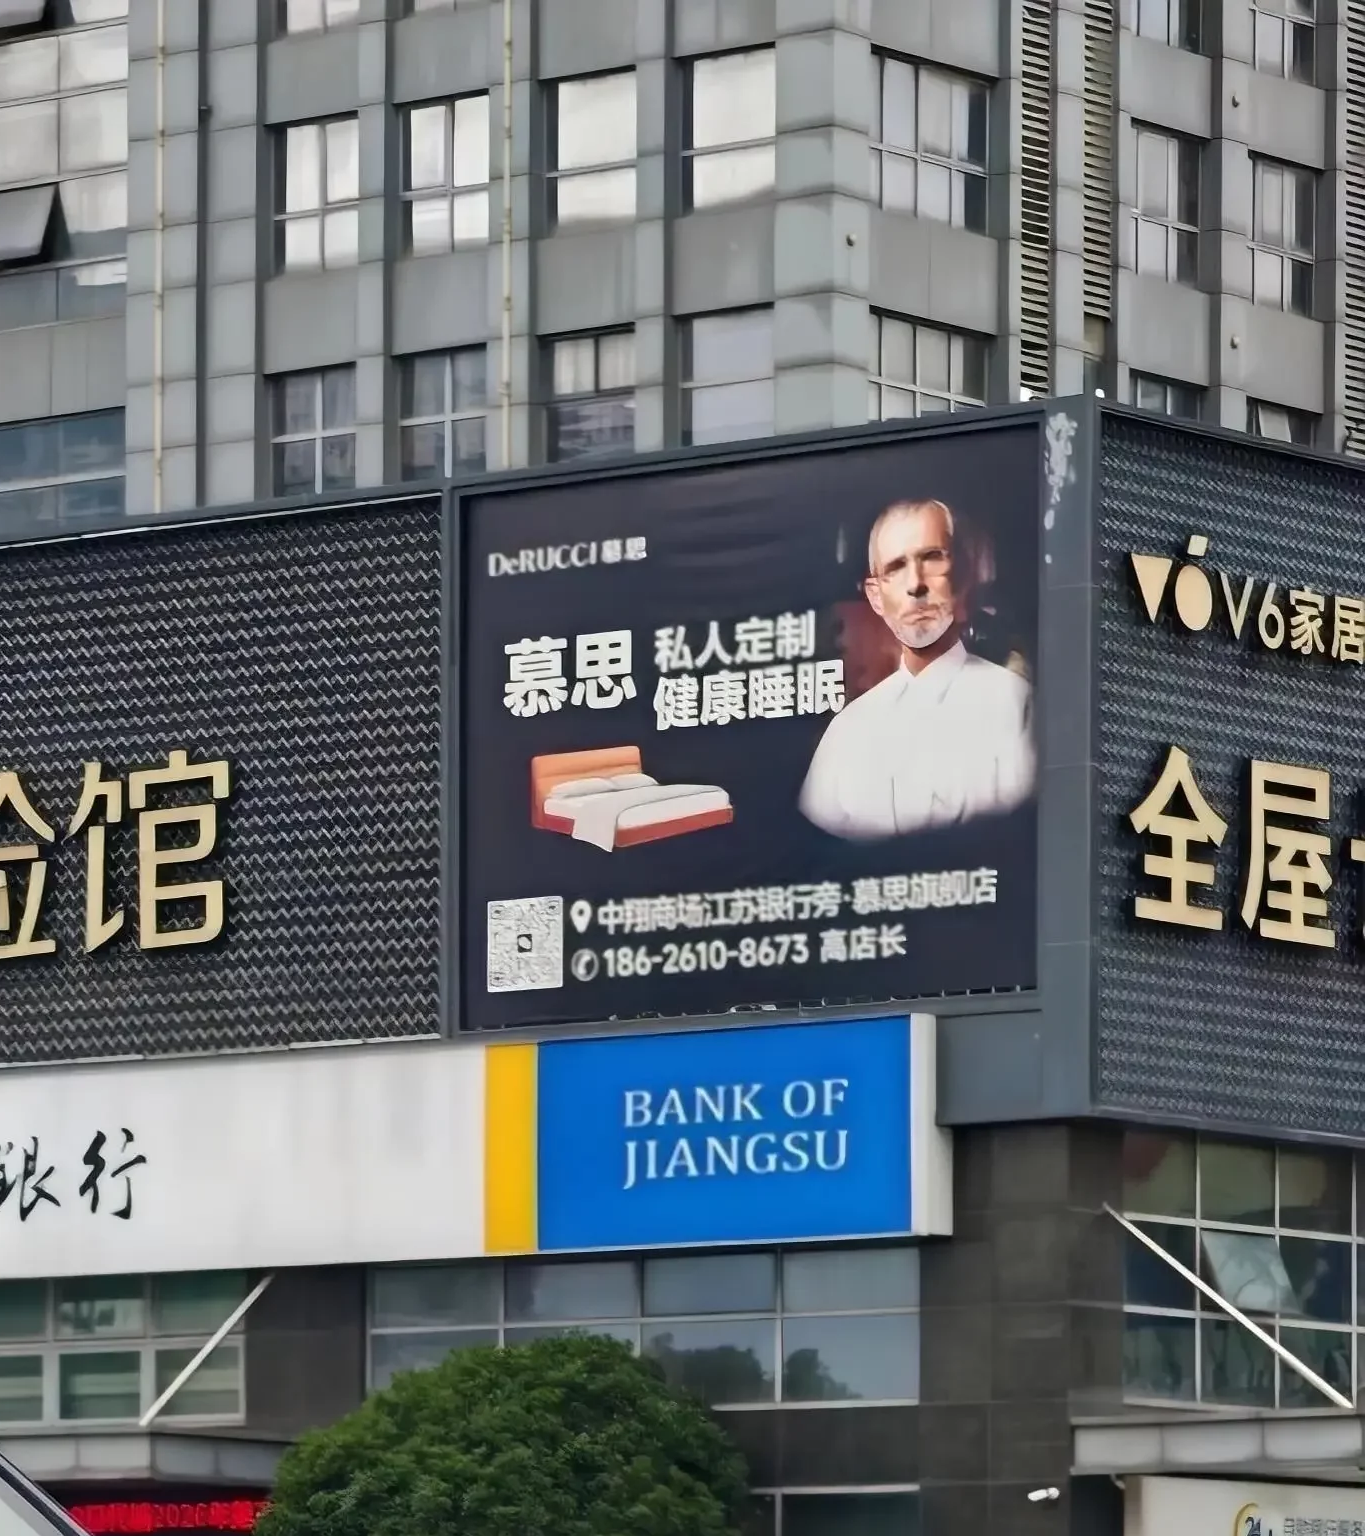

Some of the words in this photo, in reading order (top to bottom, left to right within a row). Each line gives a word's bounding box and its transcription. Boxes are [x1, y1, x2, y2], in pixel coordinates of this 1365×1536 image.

[654, 609, 818, 672] 私人定制
[503, 628, 638, 718] 慕思
[652, 658, 846, 732] 健康睡眠
[1129, 745, 1365, 950] 全屋
[603, 933, 810, 978] 186-2610-8673
[819, 924, 908, 962] 高店长
[623, 1081, 763, 1127] BANK
[783, 1078, 849, 1118] OF
[622, 1129, 849, 1190] JIANGSU
